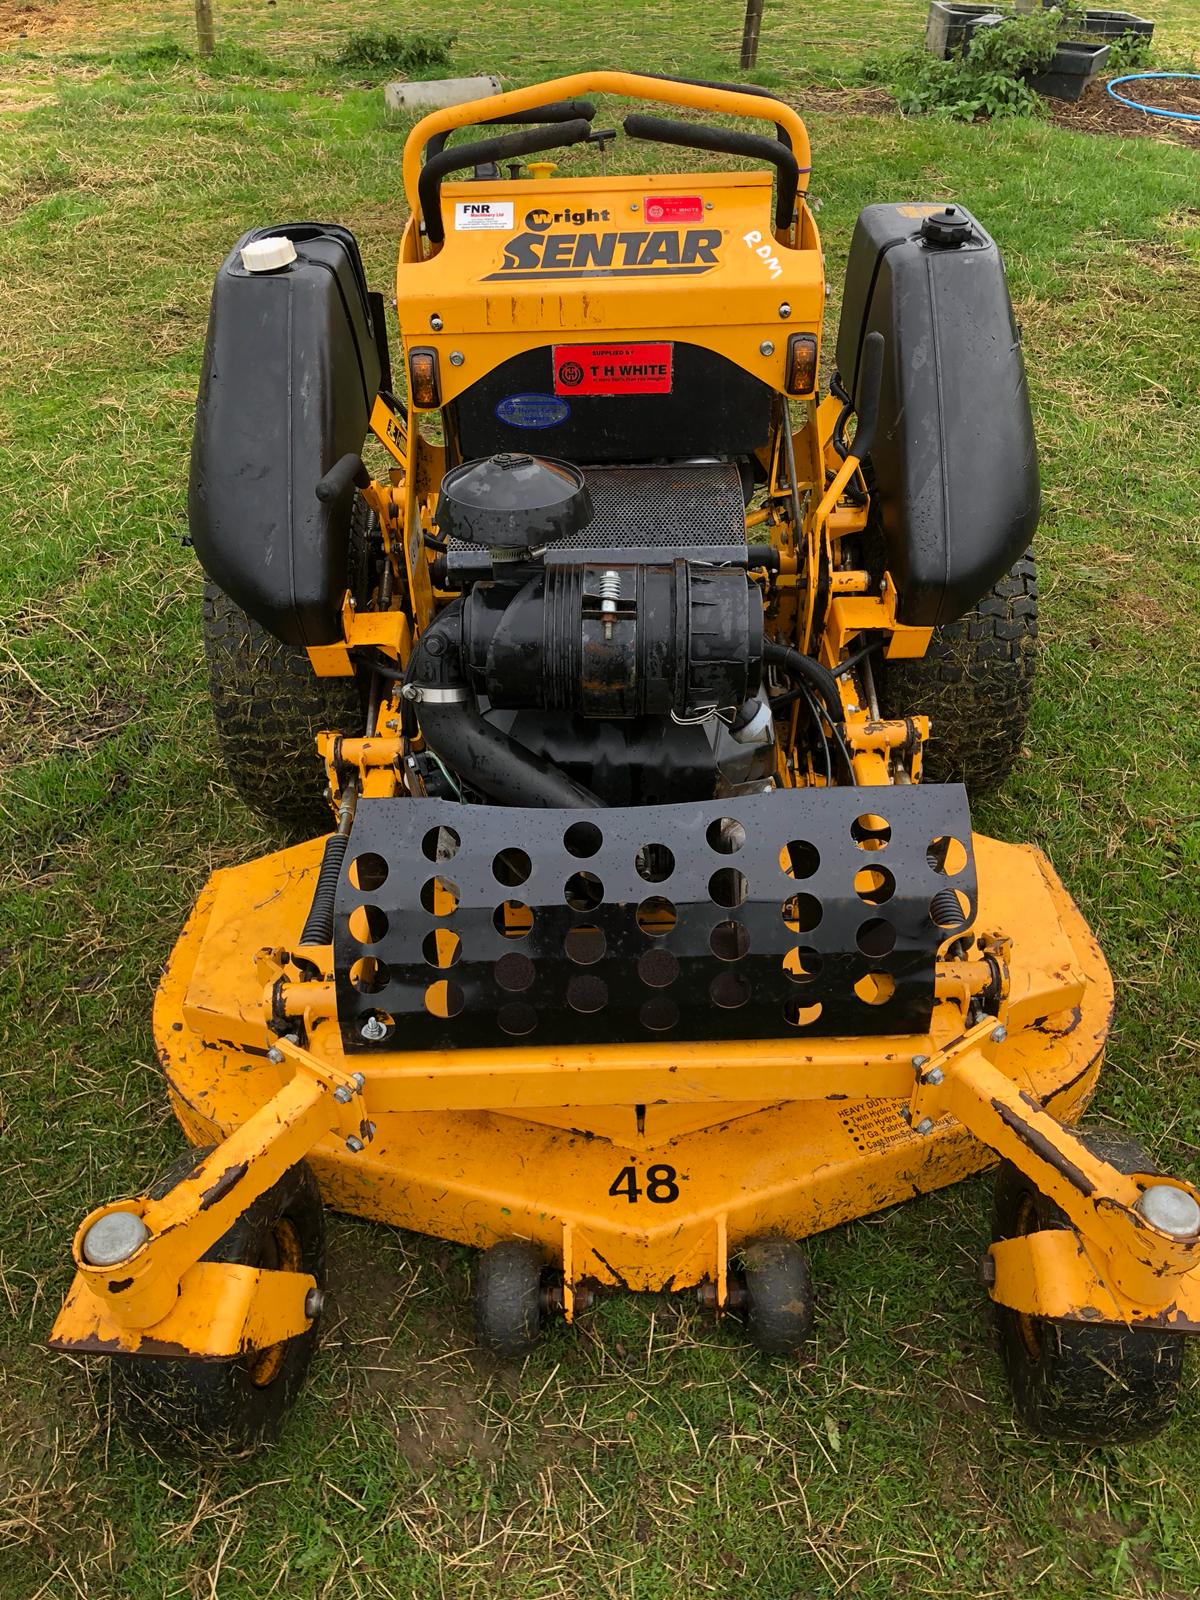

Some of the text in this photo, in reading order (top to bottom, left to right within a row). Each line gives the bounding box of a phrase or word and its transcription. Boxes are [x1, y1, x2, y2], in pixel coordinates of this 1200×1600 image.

[463, 204, 490, 214] FNR
[525, 208, 610, 231] Wright
[499, 229, 722, 270] SENTAR
[743, 230, 783, 280] RDM
[590, 364, 668, 377] T H WHITE
[837, 1097, 888, 1119] HEAVY DUTY
[850, 1113, 870, 1123] Twin
[869, 1106, 892, 1119] Hydro
[854, 1114, 897, 1132] Twin Hydro
[861, 1133, 866, 1141] 7
[866, 1138, 884, 1150] Cast
[609, 1164, 679, 1204] 48
